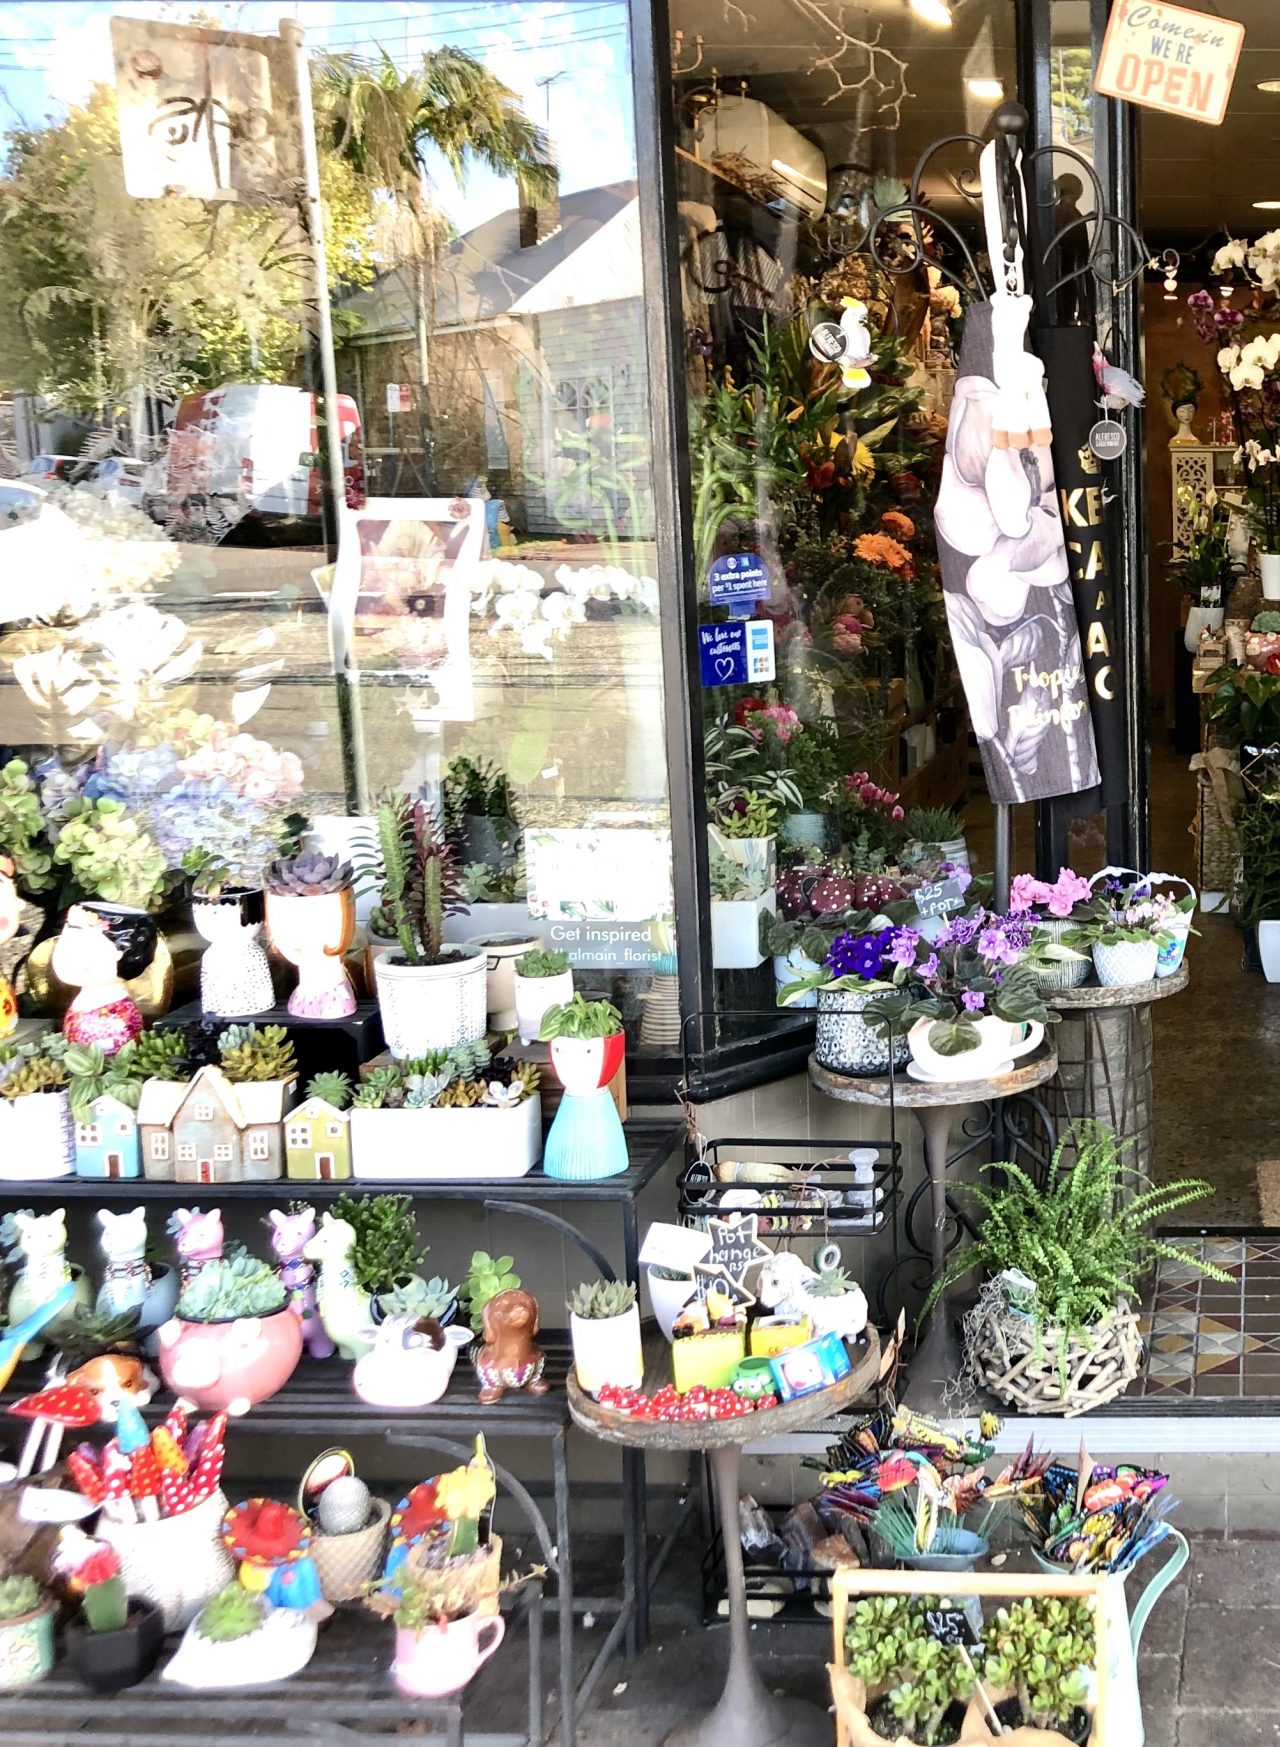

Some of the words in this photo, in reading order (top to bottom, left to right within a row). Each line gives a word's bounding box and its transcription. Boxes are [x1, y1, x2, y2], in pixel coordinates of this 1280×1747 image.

[1127, 5, 1195, 39] Come
[1200, 29, 1225, 47] in
[1151, 35, 1195, 65] WE'RE
[1115, 53, 1214, 112] OPEN
[713, 573, 720, 582] 3
[721, 572, 740, 581] extra
[741, 569, 763, 580] points
[712, 584, 725, 594] per
[725, 582, 732, 591] $1
[733, 581, 752, 592] spent
[753, 579, 767, 588] here
[701, 631, 714, 645] We
[715, 627, 729, 642] love
[730, 630, 742, 639] our
[709, 641, 741, 655] customers
[1011, 660, 1080, 699] Tropic
[551, 926, 580, 941] Get
[586, 926, 652, 944] inspired
[552, 947, 662, 965] almain_florist
[717, 1226, 752, 1246] Pot
